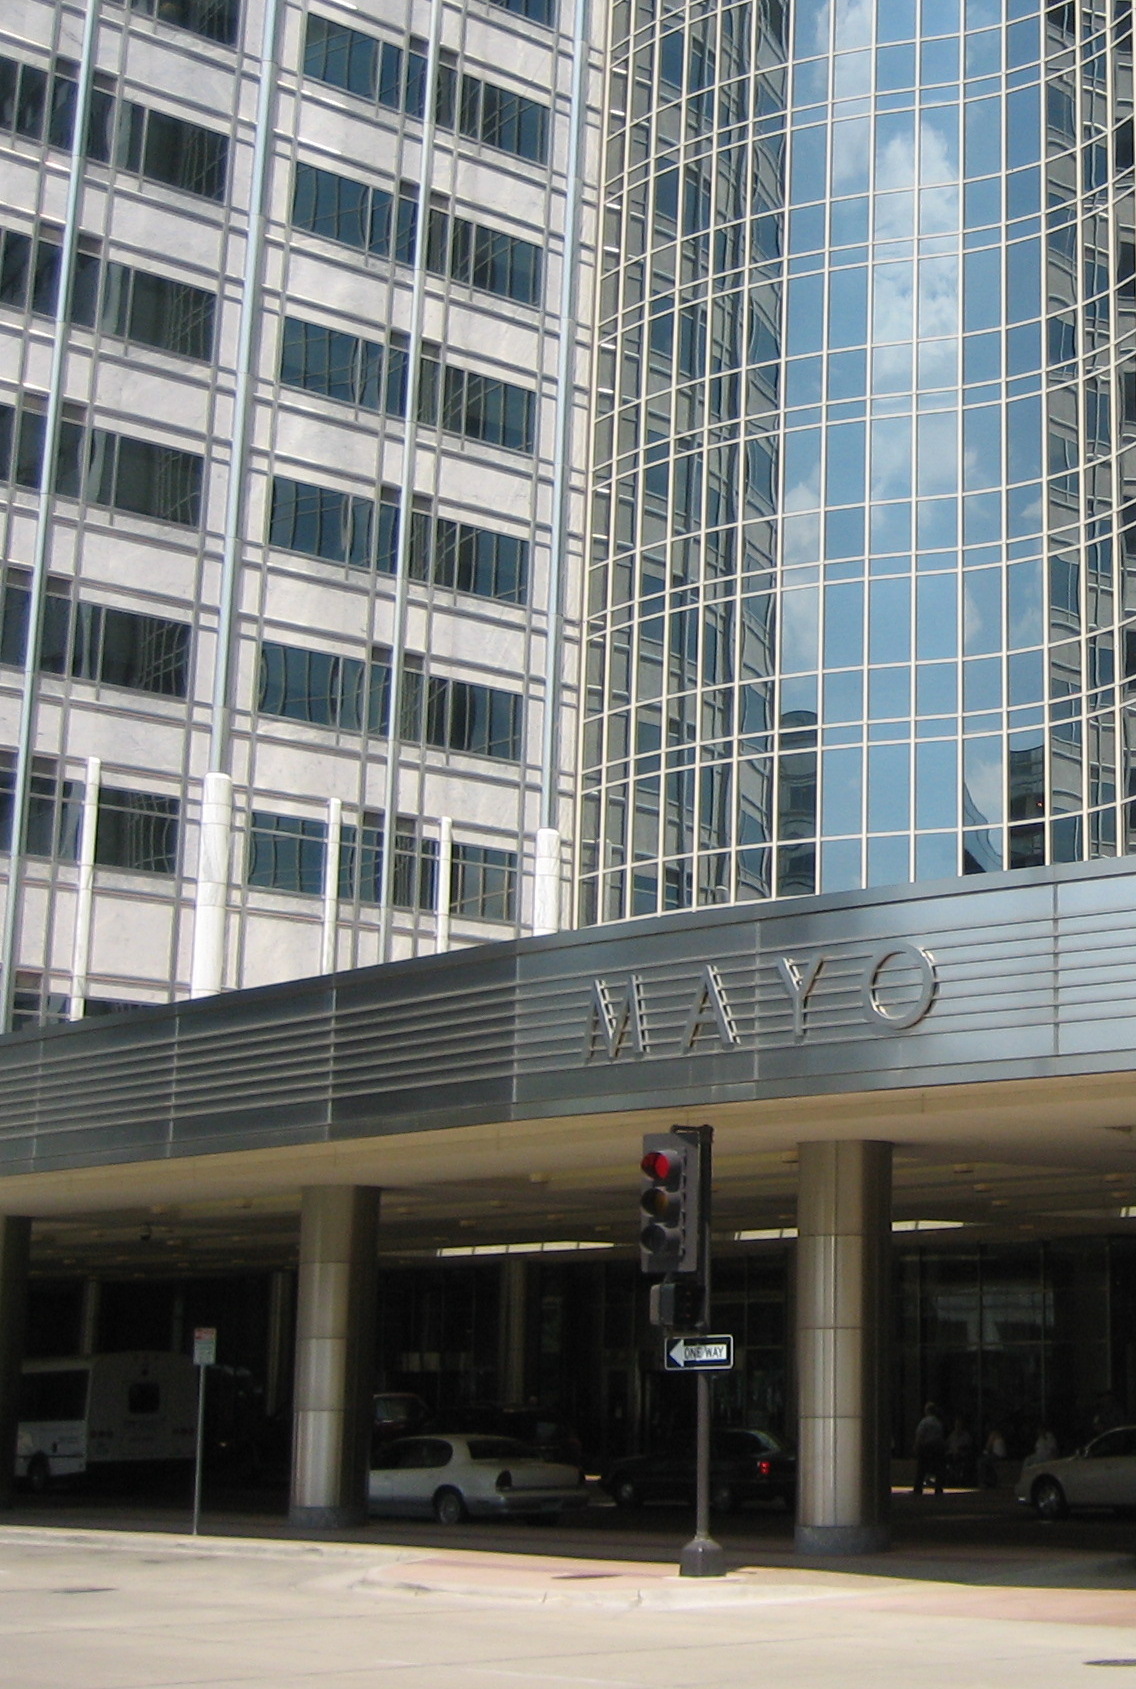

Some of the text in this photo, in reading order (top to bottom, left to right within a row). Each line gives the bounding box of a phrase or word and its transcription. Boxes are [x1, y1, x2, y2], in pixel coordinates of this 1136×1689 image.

[581, 941, 938, 1064] MAYO
[684, 1345, 725, 1360] ONE WAY
